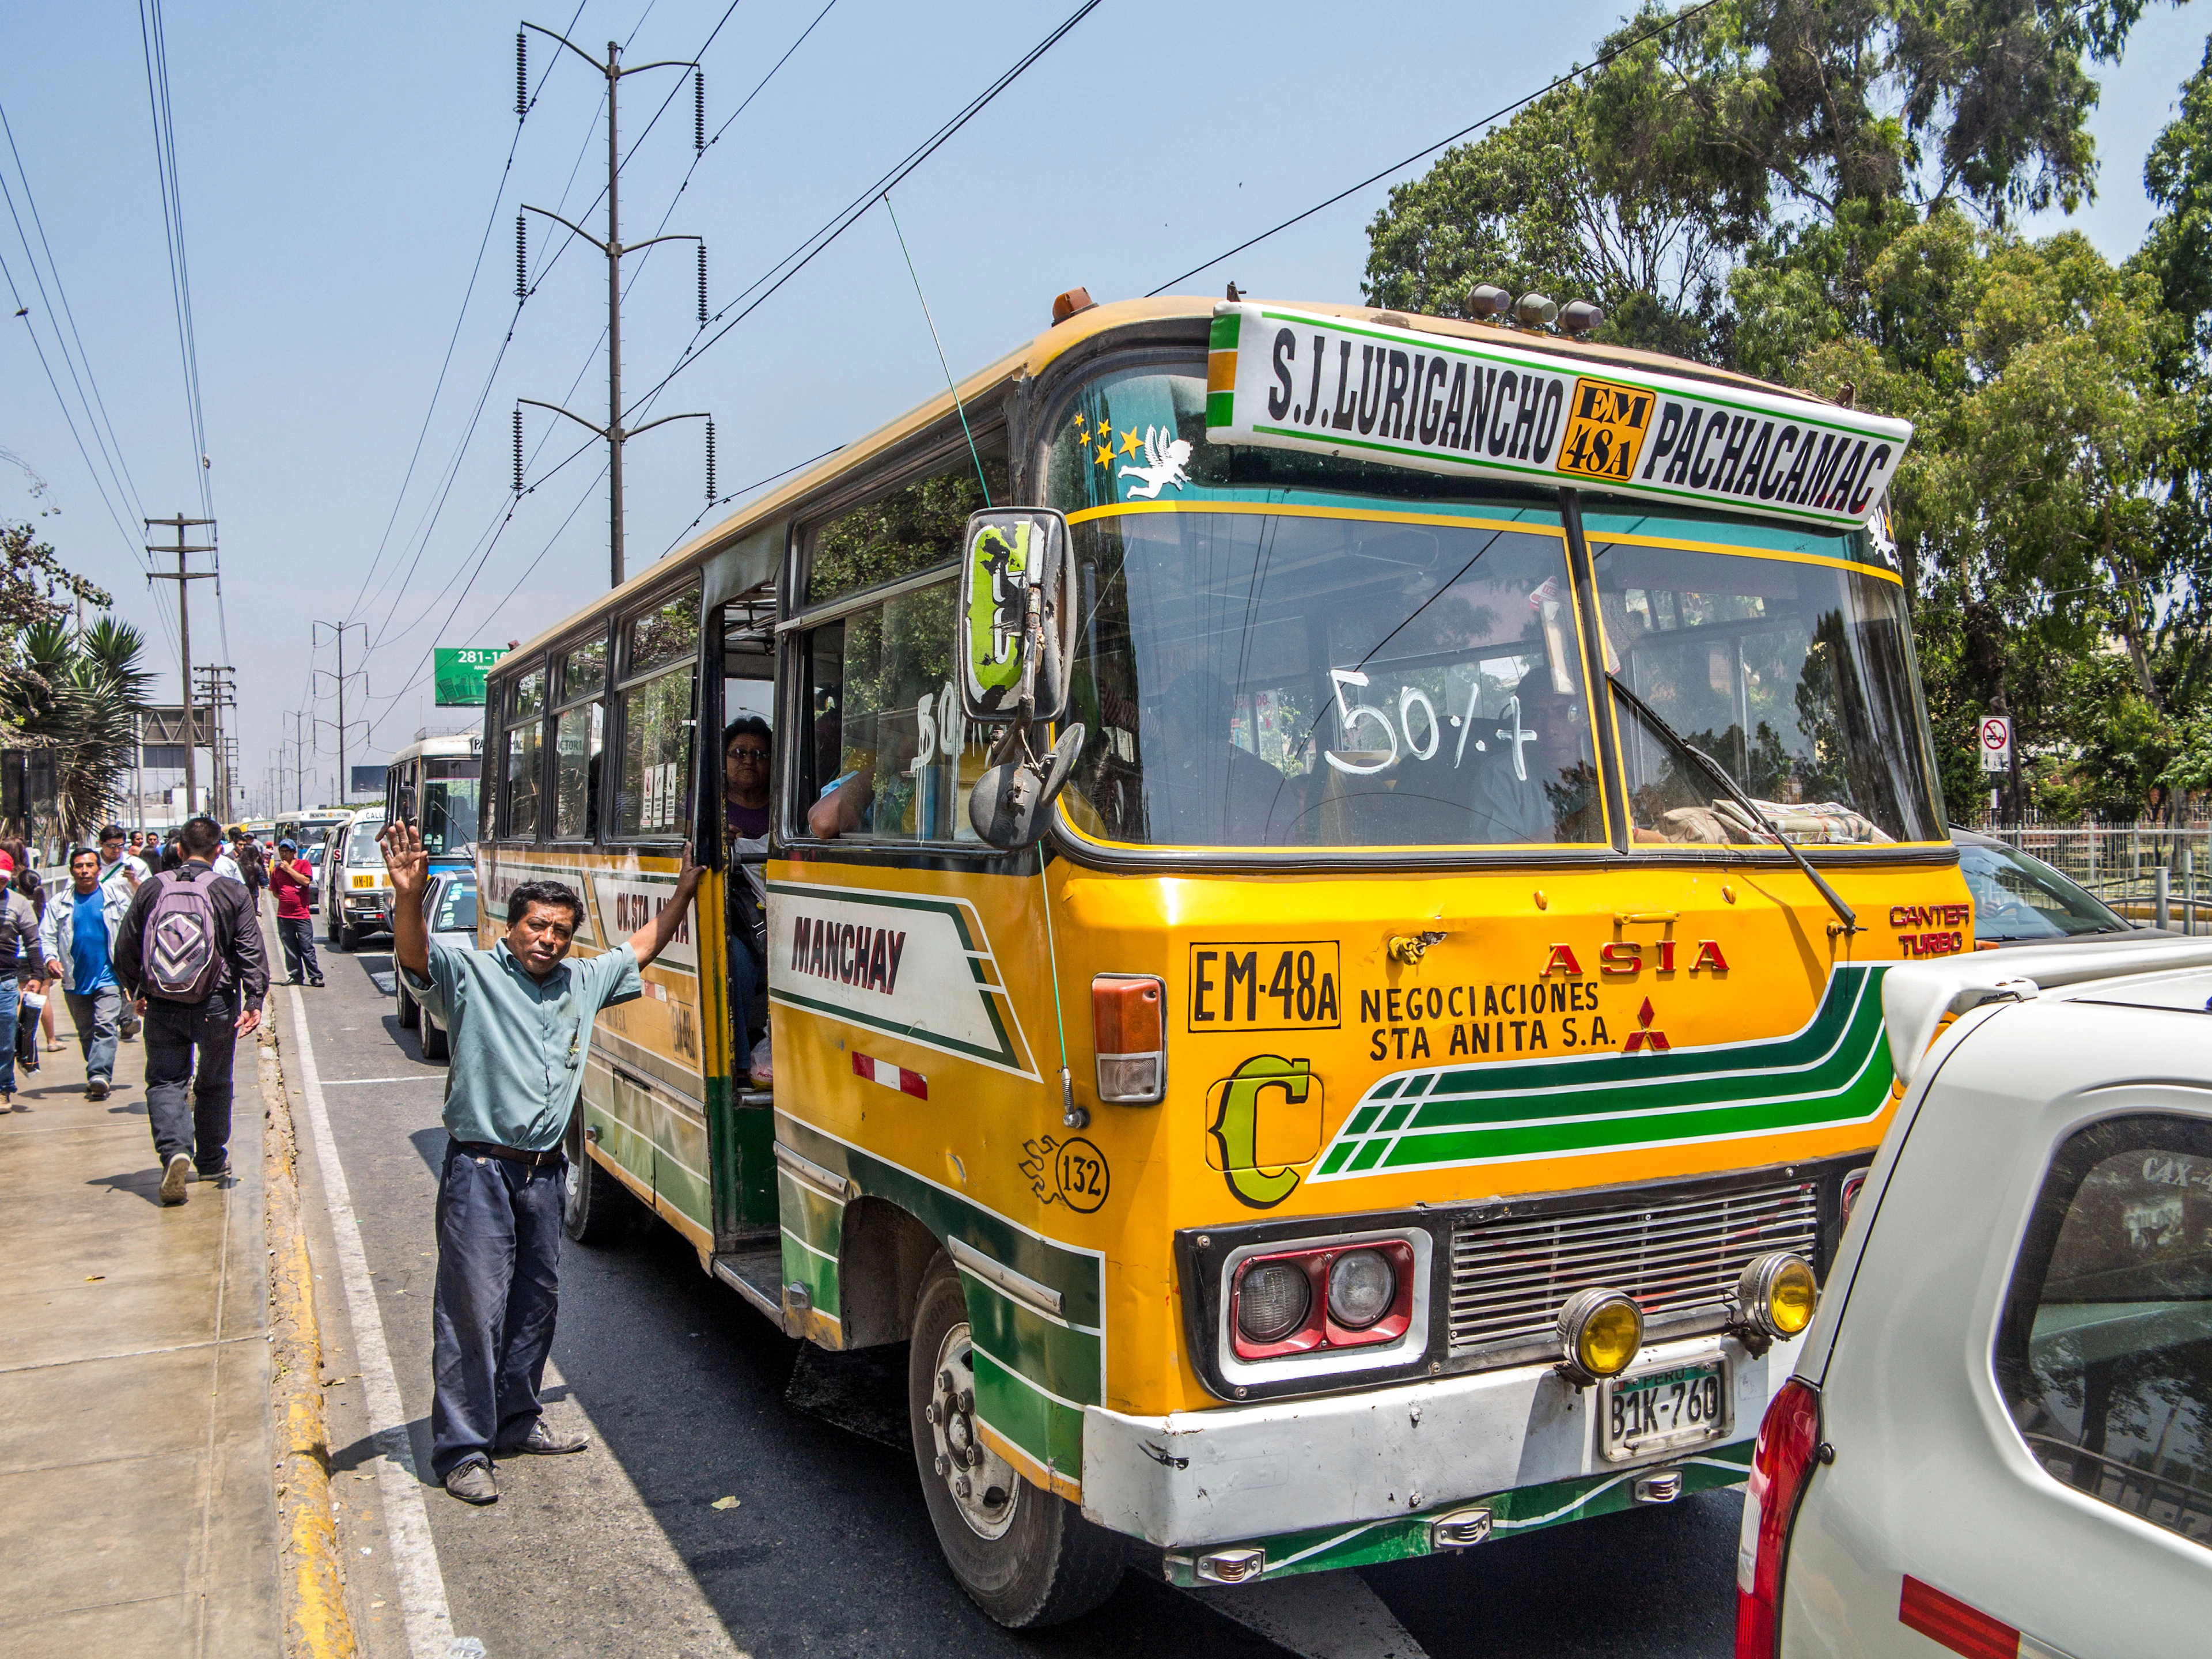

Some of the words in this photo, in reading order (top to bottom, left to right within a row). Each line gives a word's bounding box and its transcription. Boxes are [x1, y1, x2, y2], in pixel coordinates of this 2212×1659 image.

[1575, 385, 1651, 429] EM
[1566, 424, 1631, 478] 48A
[1642, 401, 1892, 514] PACHACAMAC
[1889, 903, 1969, 926] CANTER
[791, 916, 906, 995] MANCHAY
[1539, 940, 1730, 977] ASIA
[1899, 931, 1963, 956] TURBO
[1361, 982, 1599, 1023] NEGOCIACIONES
[1370, 1026, 1431, 1061] STA
[1449, 1018, 1548, 1056] ANITA
[1562, 1016, 1617, 1047] S.A.
[1063, 1154, 1101, 1196] 132
[1644, 1371, 1684, 1387] PERU
[1612, 1376, 1718, 1440] B1K-760
